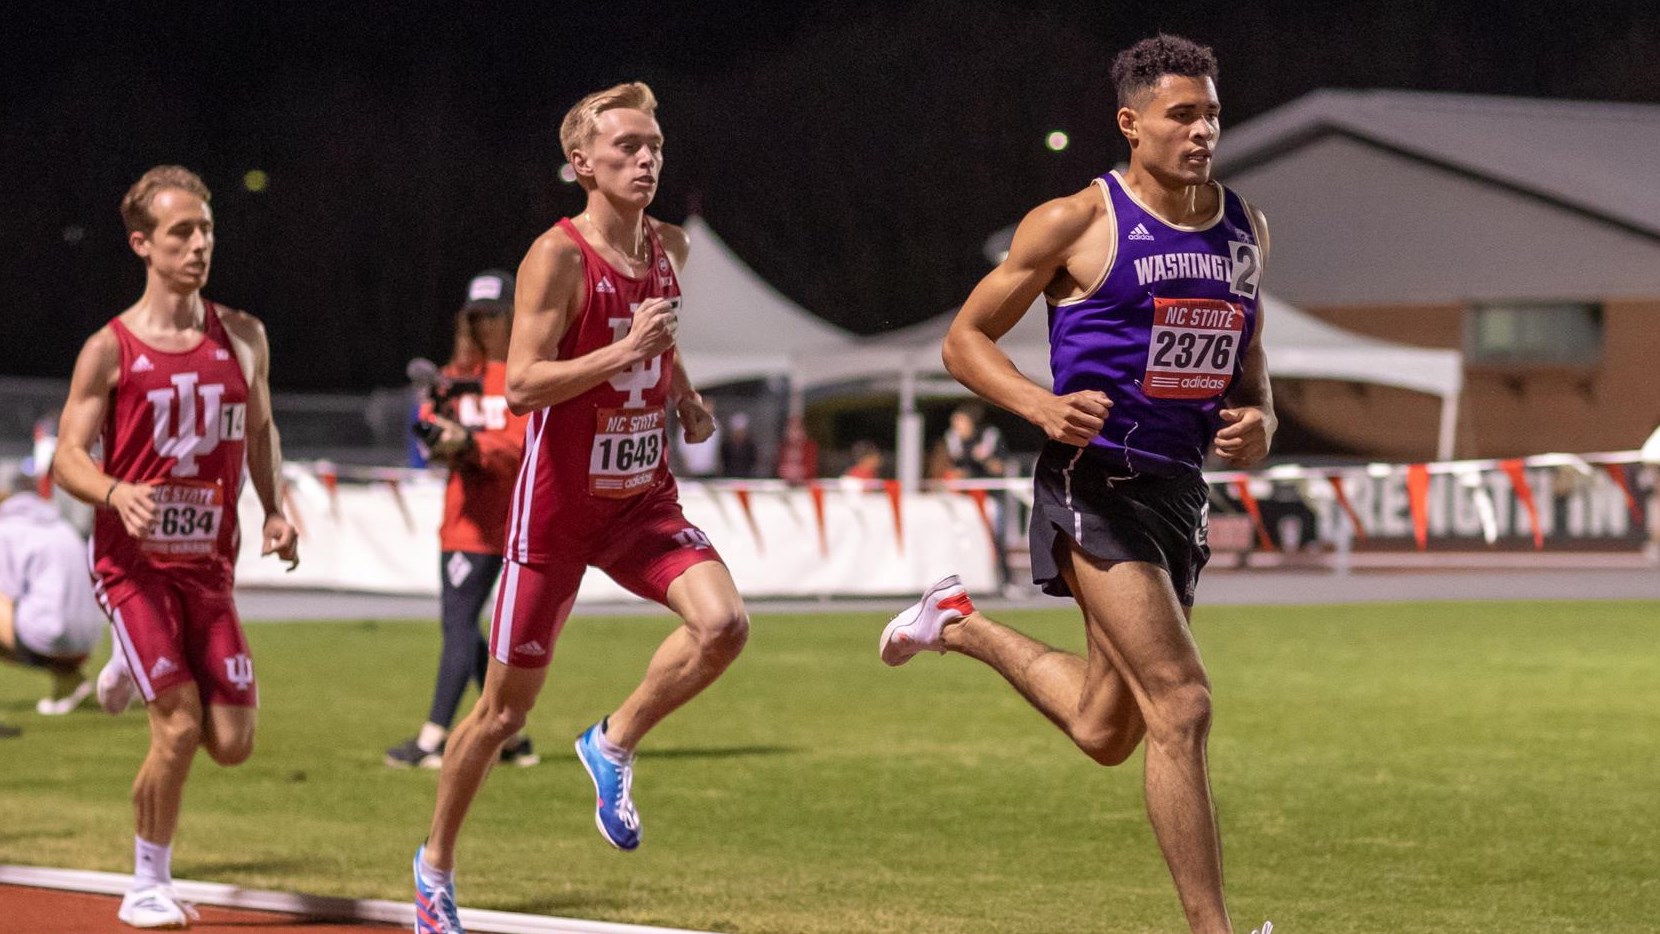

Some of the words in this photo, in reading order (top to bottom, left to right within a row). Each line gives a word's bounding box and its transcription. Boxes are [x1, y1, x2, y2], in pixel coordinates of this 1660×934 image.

[1134, 252, 1232, 286] WASHINGT
[1235, 245, 1257, 295] 2
[1165, 306, 1187, 326] NC
[1190, 308, 1235, 328] STATE
[1153, 331, 1233, 370] 2376
[1180, 376, 1225, 390] adidas
[605, 416, 627, 433] NC
[629, 413, 659, 432] STATE
[599, 434, 659, 471] 1643
